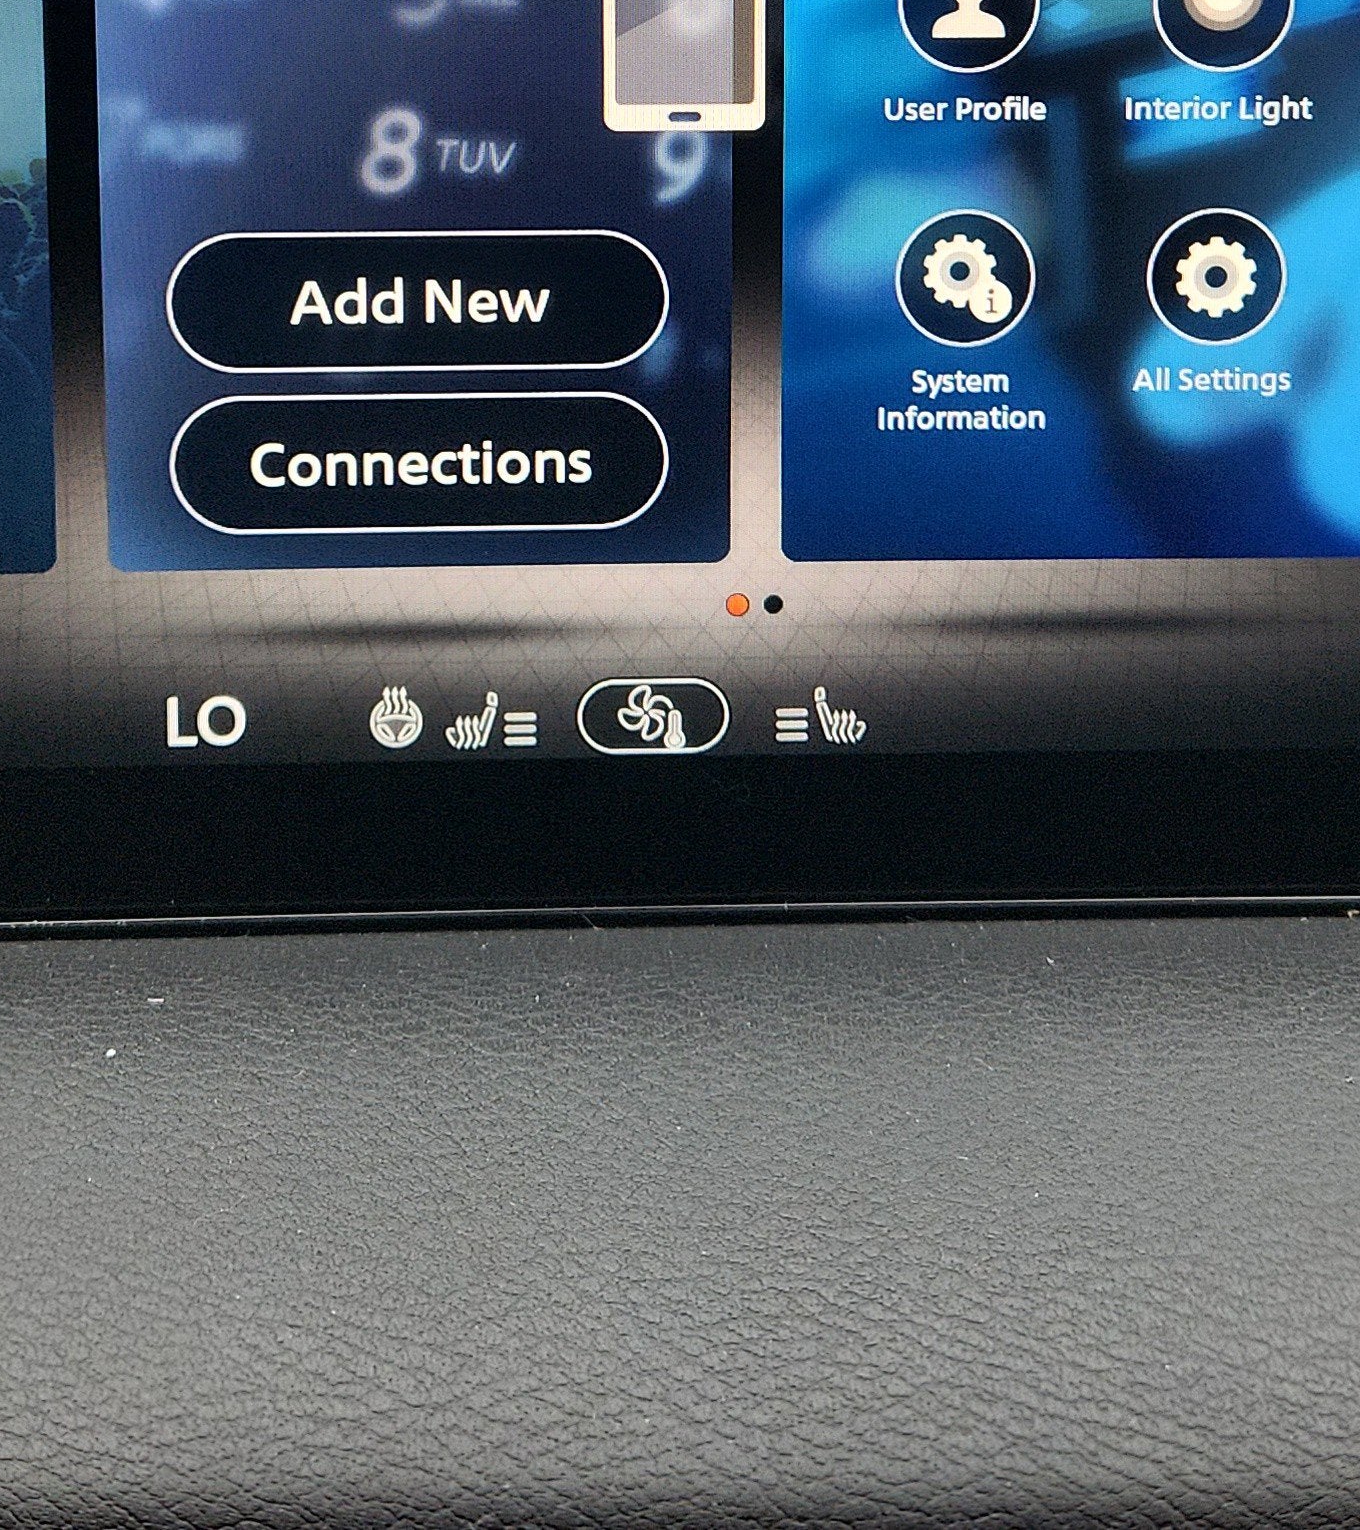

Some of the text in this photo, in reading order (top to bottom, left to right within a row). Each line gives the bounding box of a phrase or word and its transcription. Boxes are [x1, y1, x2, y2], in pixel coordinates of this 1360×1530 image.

[884, 95, 1047, 121] User Profile
[1125, 95, 1312, 126] Interior Light
[359, 108, 517, 196] 8 TUV
[652, 130, 710, 204] 9
[290, 276, 550, 325] Add New
[912, 369, 1009, 398] System
[1133, 368, 1290, 396] All Settings
[878, 404, 1046, 430] Information
[250, 440, 592, 488] Connections
[167, 695, 246, 747] LO
